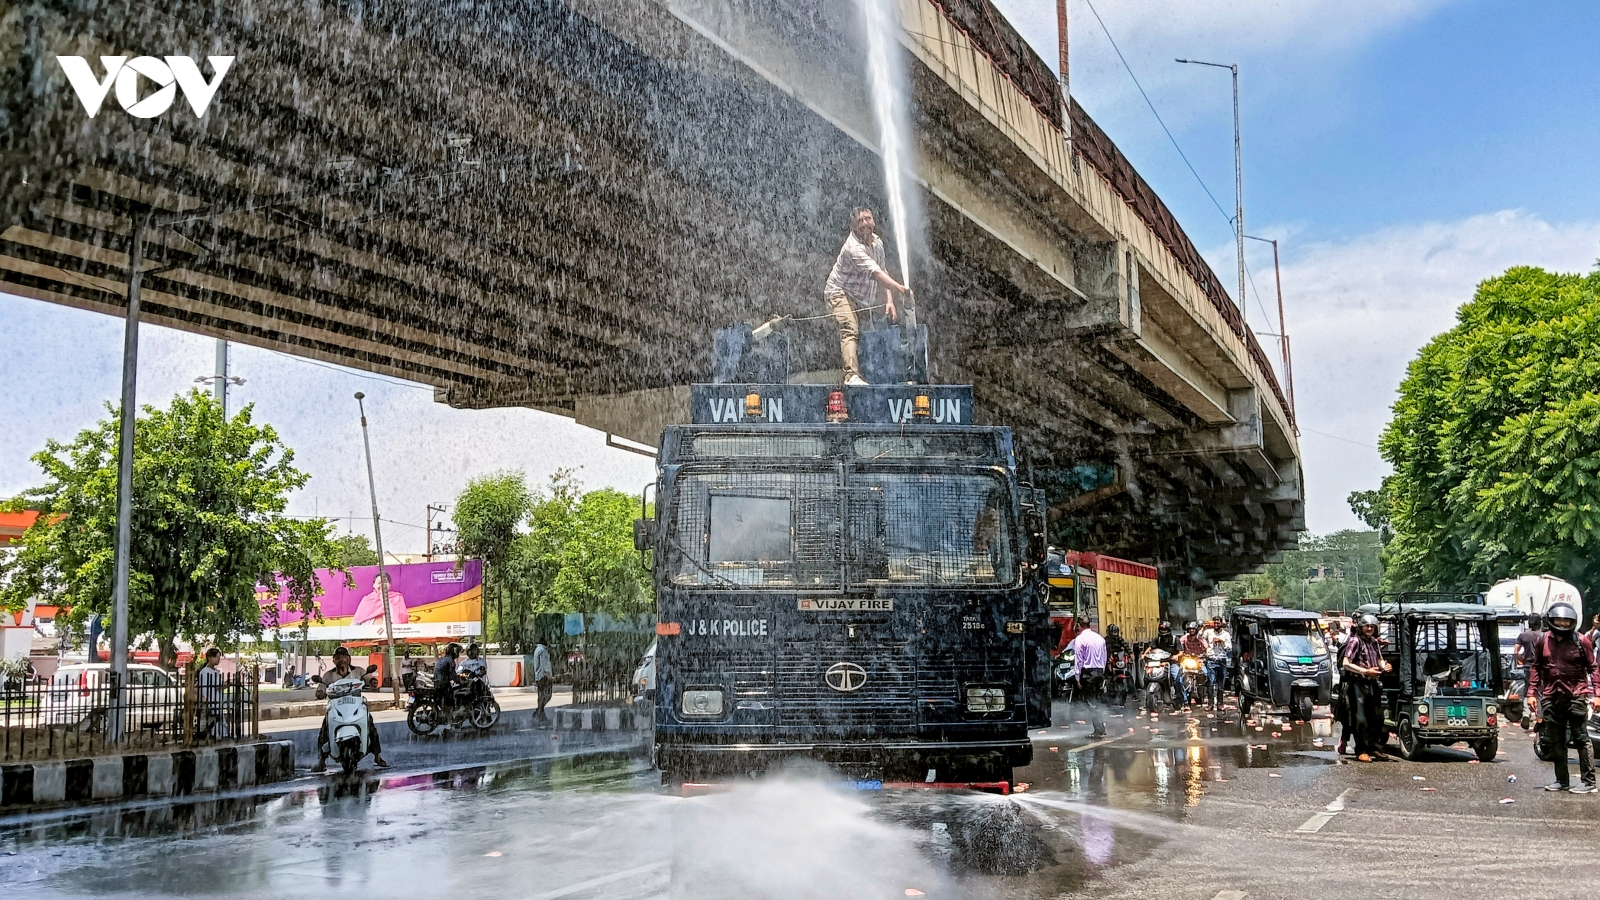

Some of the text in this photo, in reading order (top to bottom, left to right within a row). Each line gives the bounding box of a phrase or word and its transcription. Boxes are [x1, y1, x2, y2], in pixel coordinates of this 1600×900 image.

[888, 398, 961, 423] VAUN
[815, 600, 855, 609] VIJAY
[859, 600, 890, 609] FIRE
[688, 619, 768, 636] J & K POLICE
